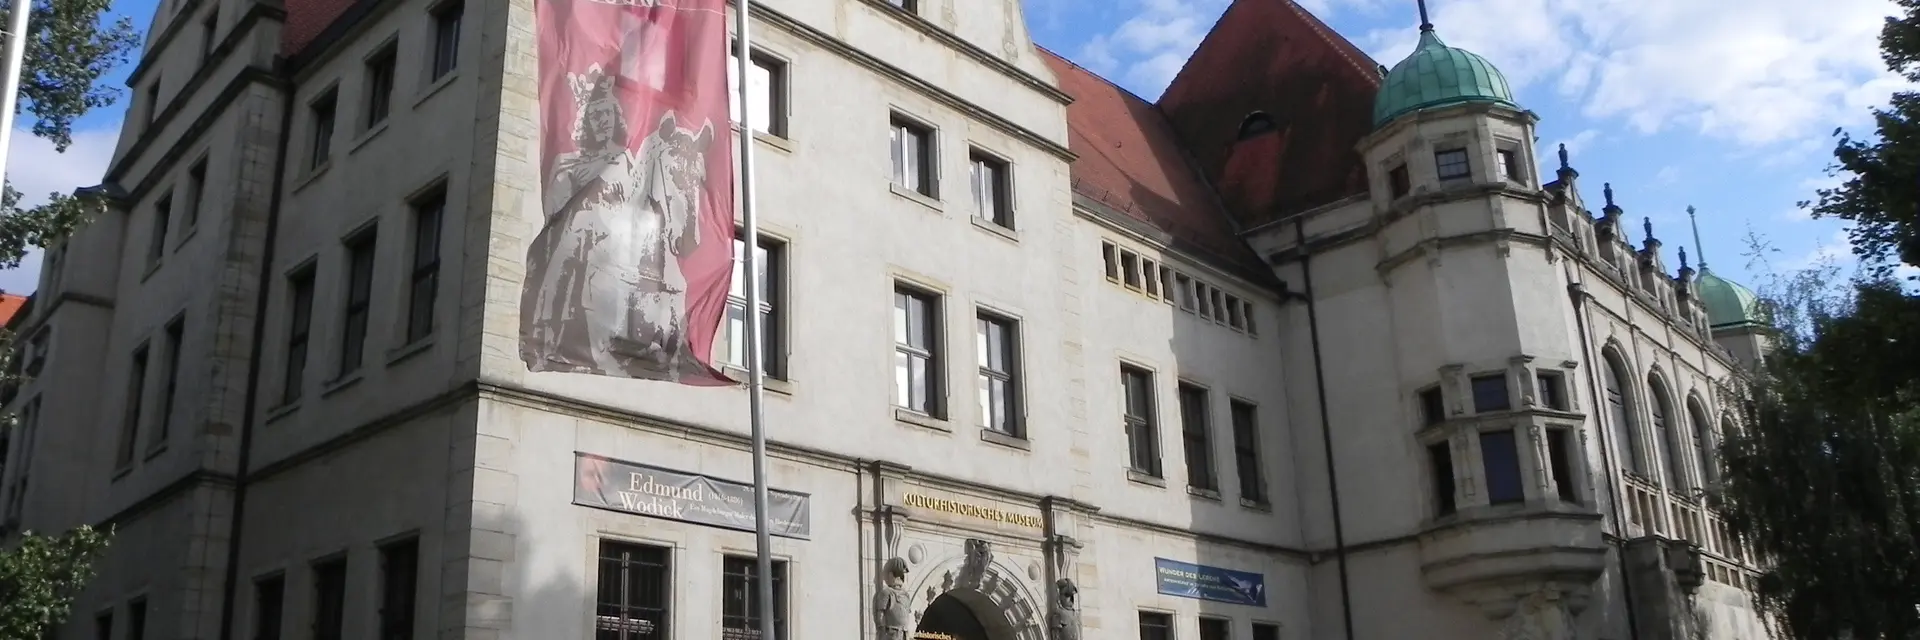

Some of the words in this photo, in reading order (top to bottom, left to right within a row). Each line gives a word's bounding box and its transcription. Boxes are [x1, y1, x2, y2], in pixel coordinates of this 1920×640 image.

[628, 471, 703, 502] Edmund
[617, 490, 684, 519] Wodick
[903, 492, 1003, 522] KULTURHISTORISCHES
[1005, 511, 1044, 529] MUSEUM
[1159, 567, 1184, 578] WUNDER
[1185, 571, 1197, 580] DES
